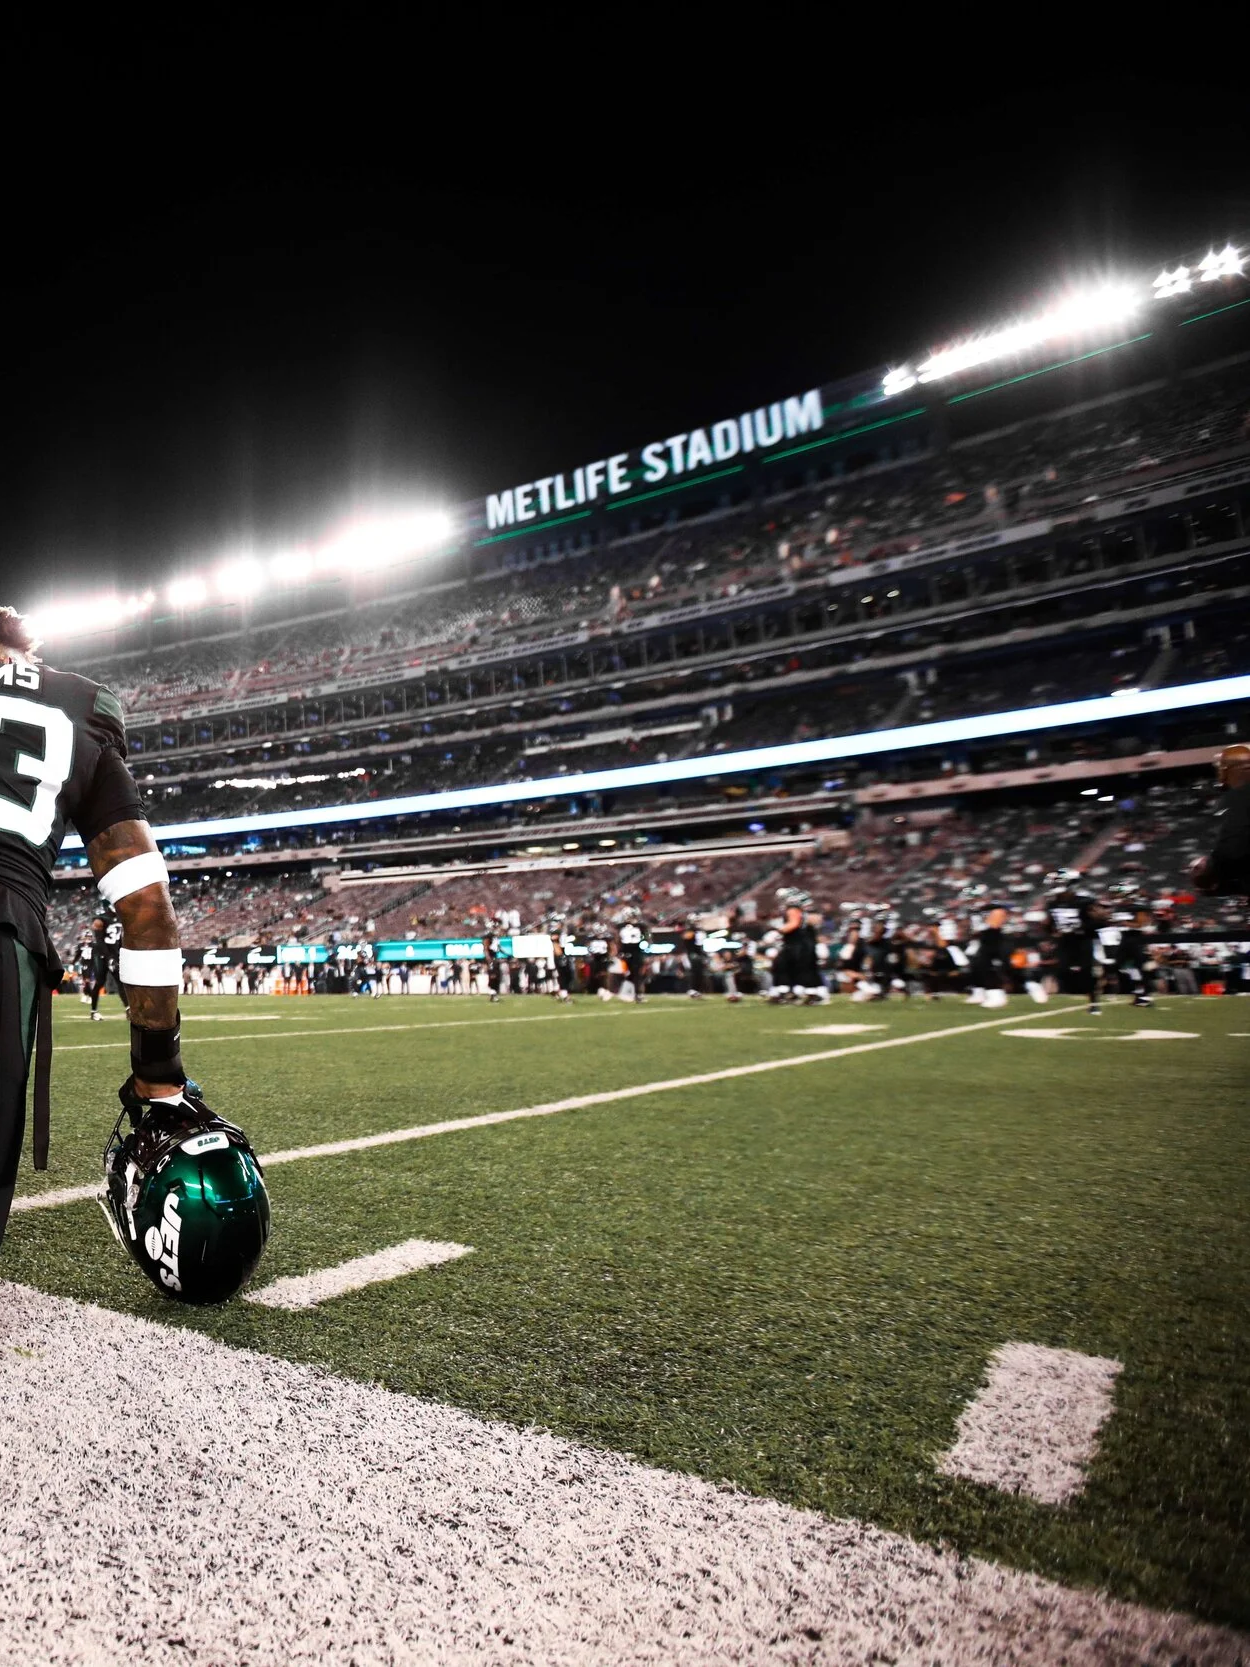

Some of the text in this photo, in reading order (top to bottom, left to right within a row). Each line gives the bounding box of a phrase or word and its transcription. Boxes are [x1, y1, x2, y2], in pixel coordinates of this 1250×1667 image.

[485, 387, 825, 531] METLIFE STADIUM
[160, 1191, 183, 1292] JETS
